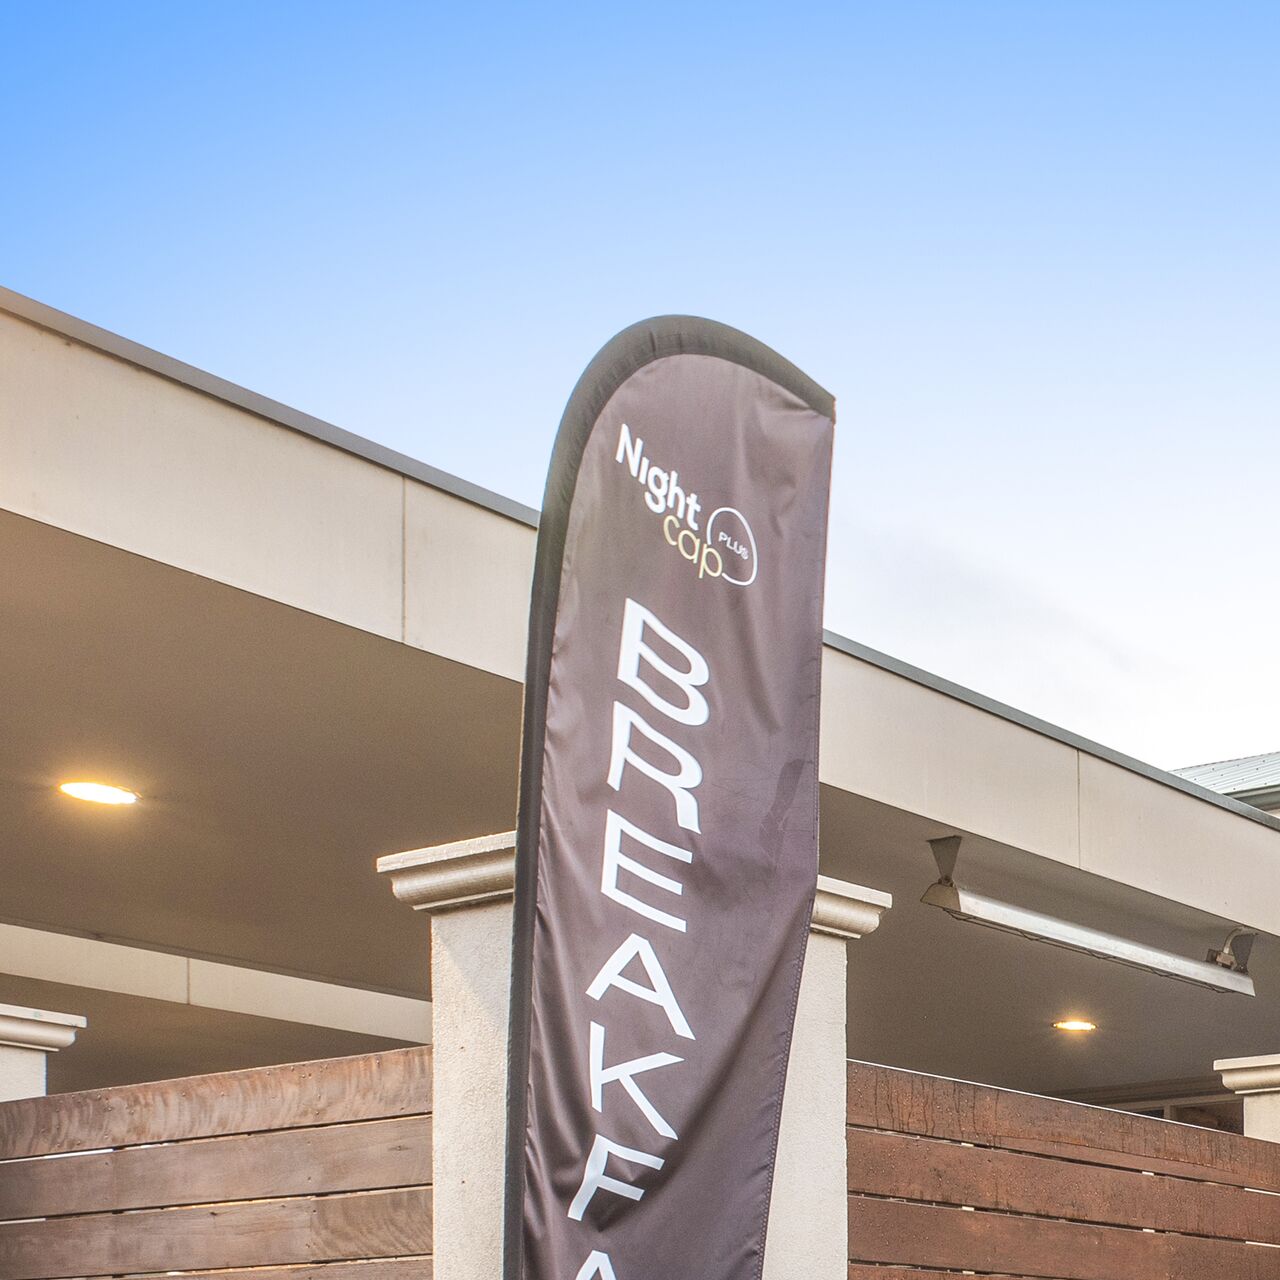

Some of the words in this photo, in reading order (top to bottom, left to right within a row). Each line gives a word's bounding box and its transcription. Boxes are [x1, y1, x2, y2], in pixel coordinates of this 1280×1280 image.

[615, 423, 702, 531] Night
[663, 514, 723, 579] cap
[718, 531, 749, 560] PLUS
